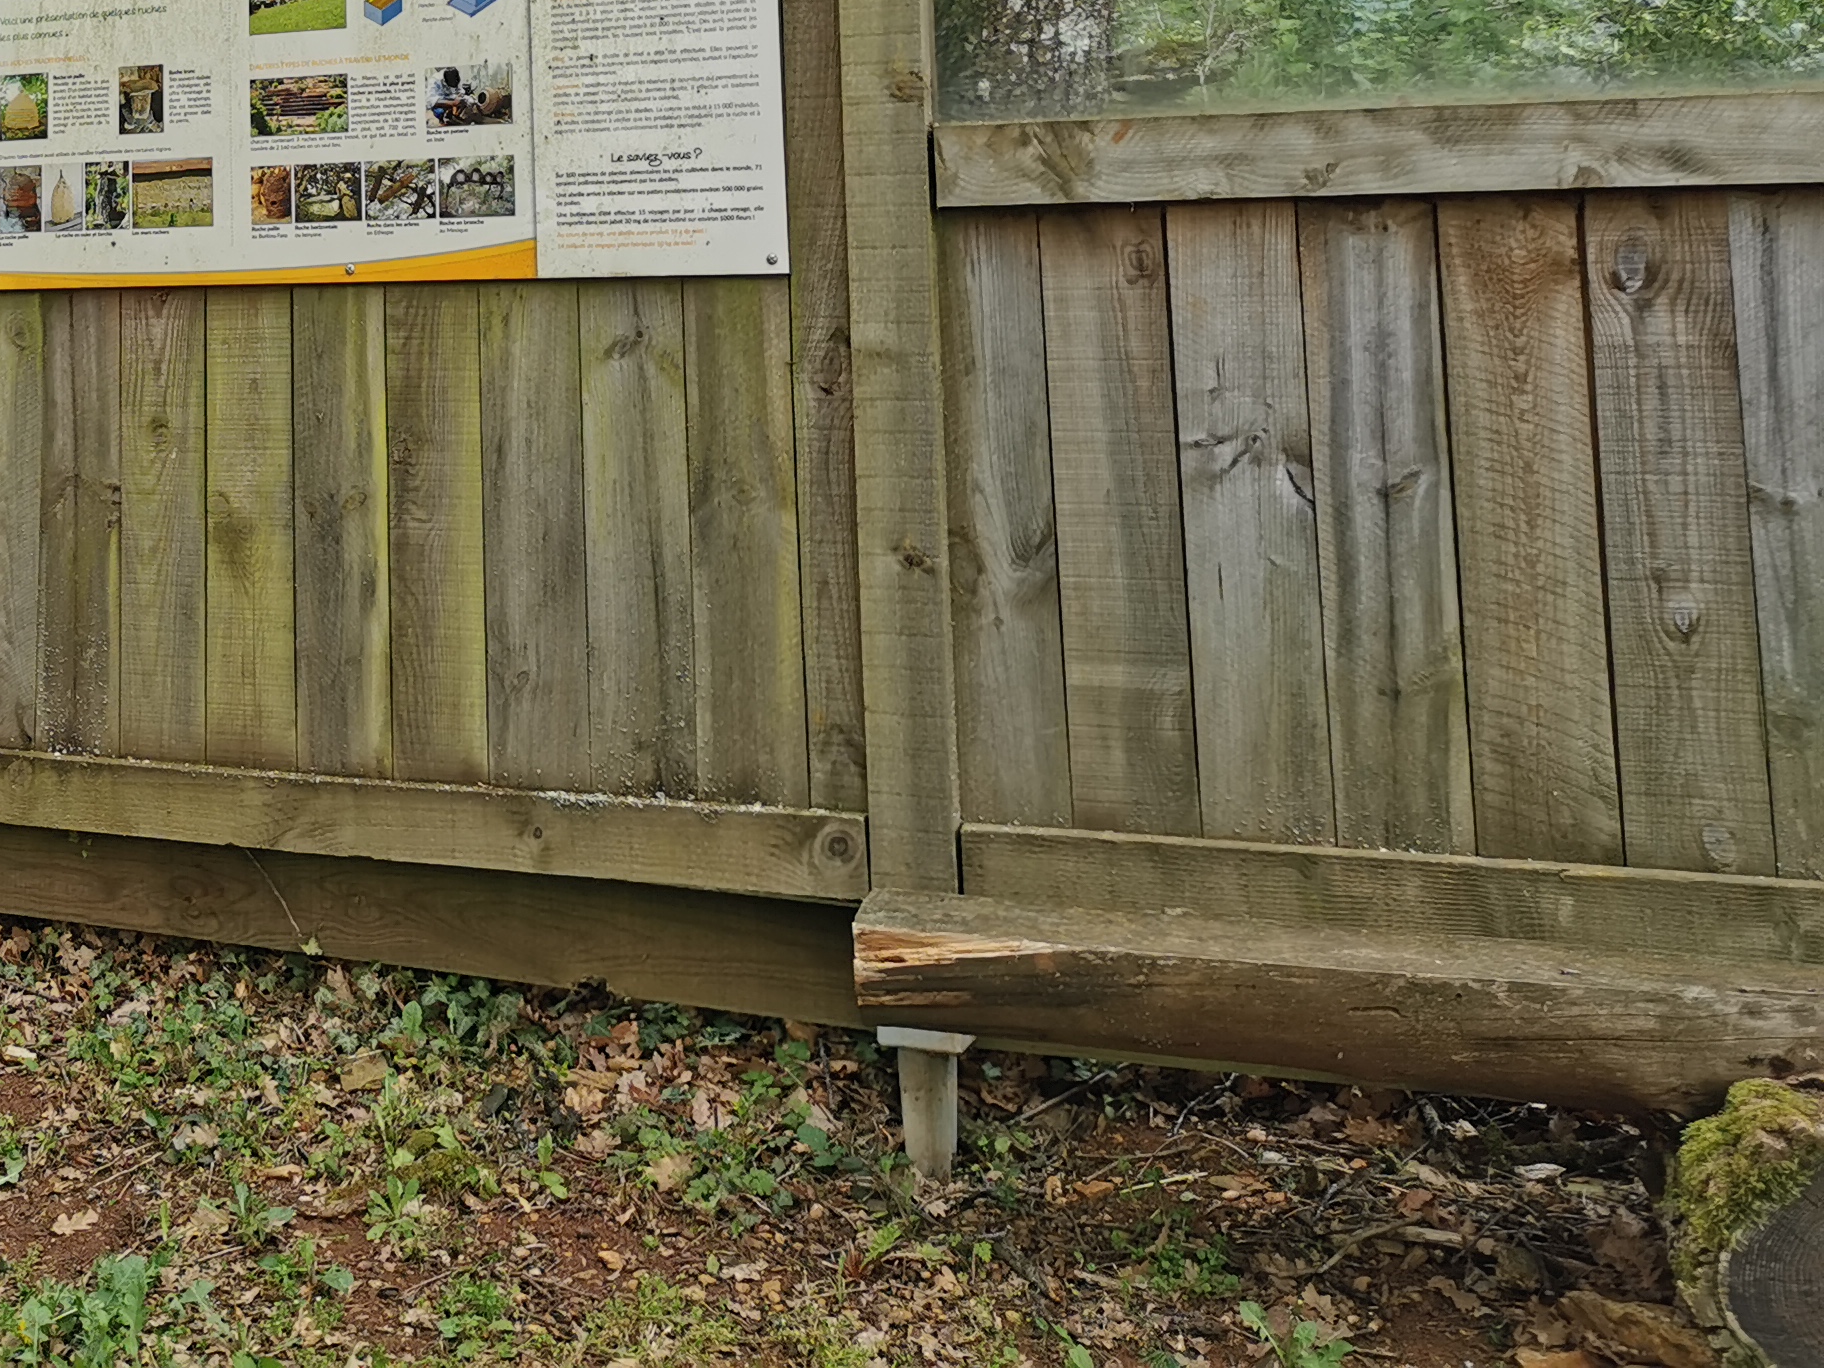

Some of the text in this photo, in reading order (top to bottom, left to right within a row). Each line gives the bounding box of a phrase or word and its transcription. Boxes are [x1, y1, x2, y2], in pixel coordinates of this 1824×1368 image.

[19, 16, 34, 24] une
[89, 10, 100, 18] de
[101, 7, 136, 21] quelques
[137, 5, 167, 14] ruches
[0, 34, 10, 42] les
[12, 32, 28, 43] plus
[611, 153, 624, 162] Le
[694, 147, 702, 159] ?
